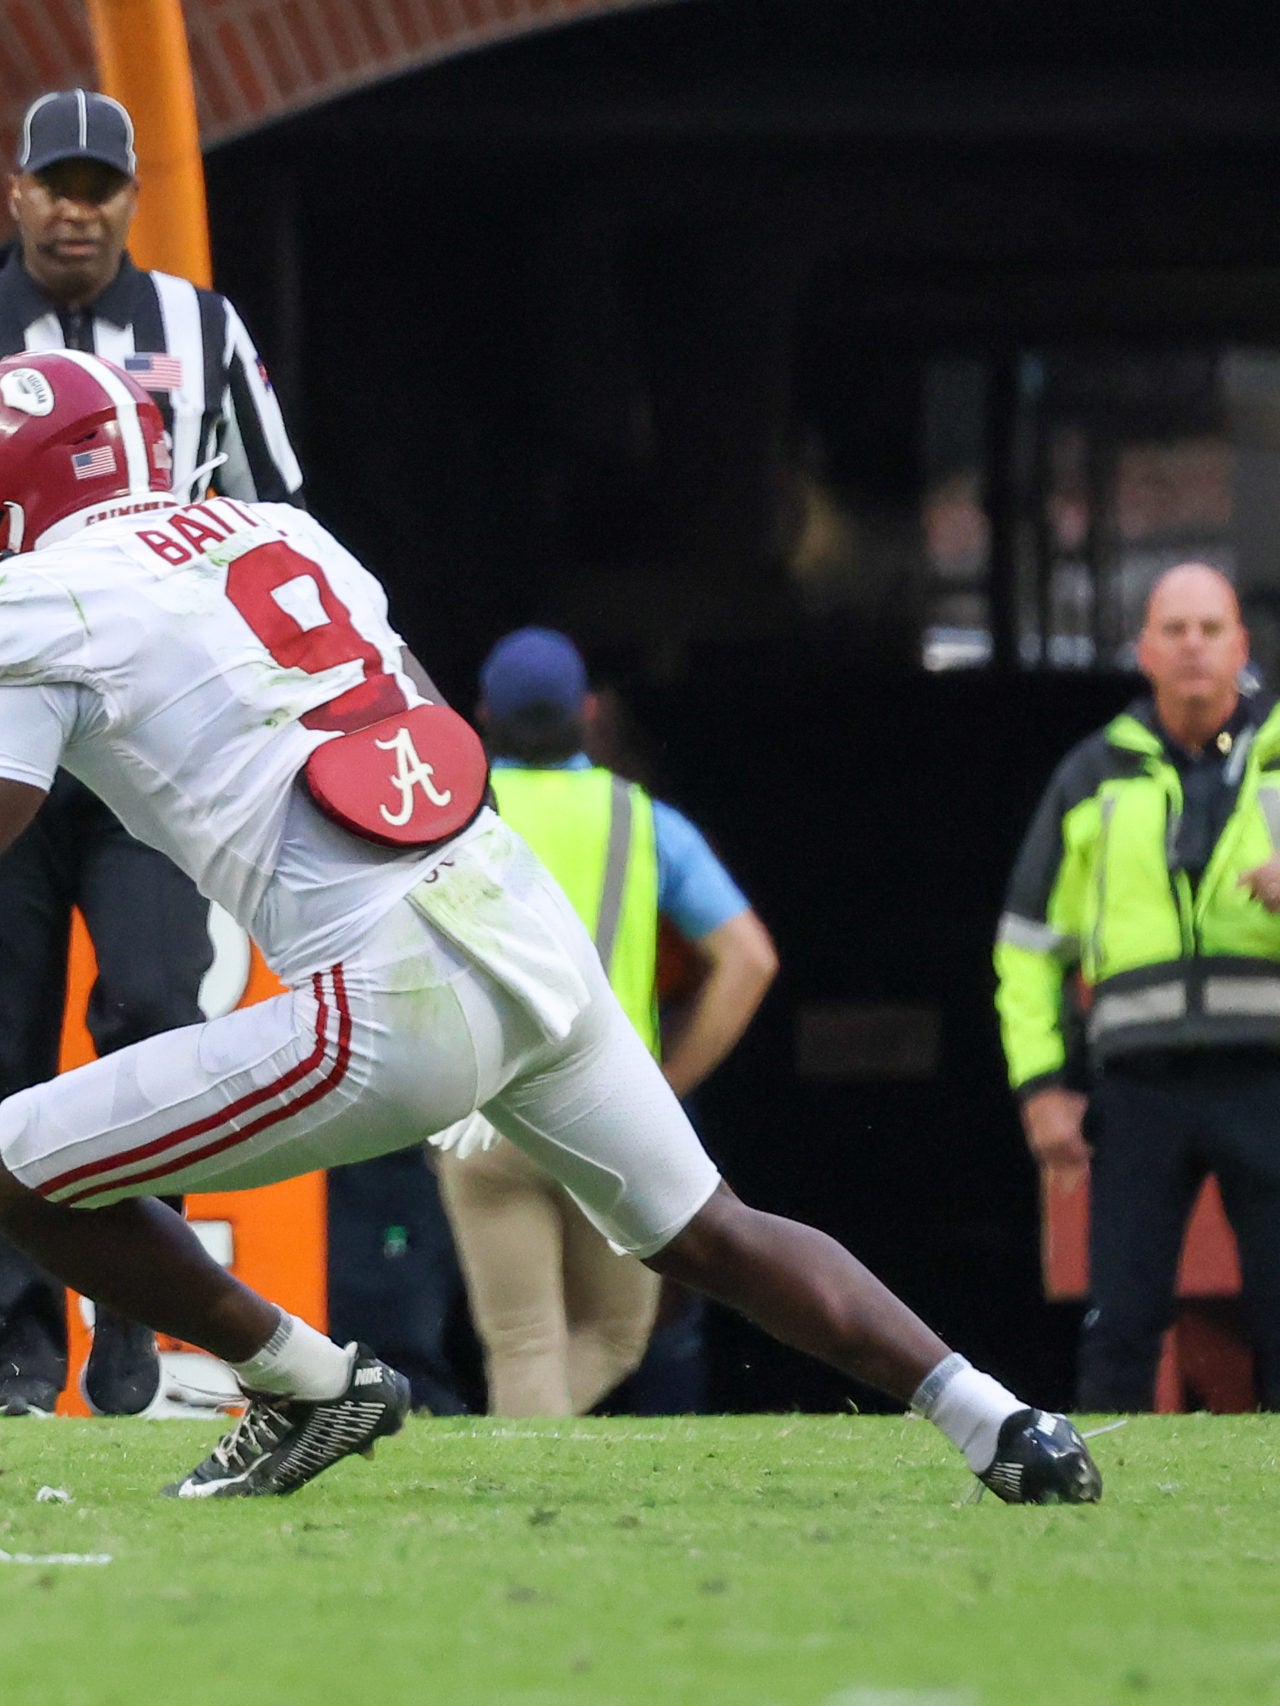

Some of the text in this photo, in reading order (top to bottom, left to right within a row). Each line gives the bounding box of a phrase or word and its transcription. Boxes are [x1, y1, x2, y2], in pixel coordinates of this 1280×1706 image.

[225, 540, 409, 735] 9
[375, 727, 452, 827] A
[354, 1366, 384, 1387] NIKE
